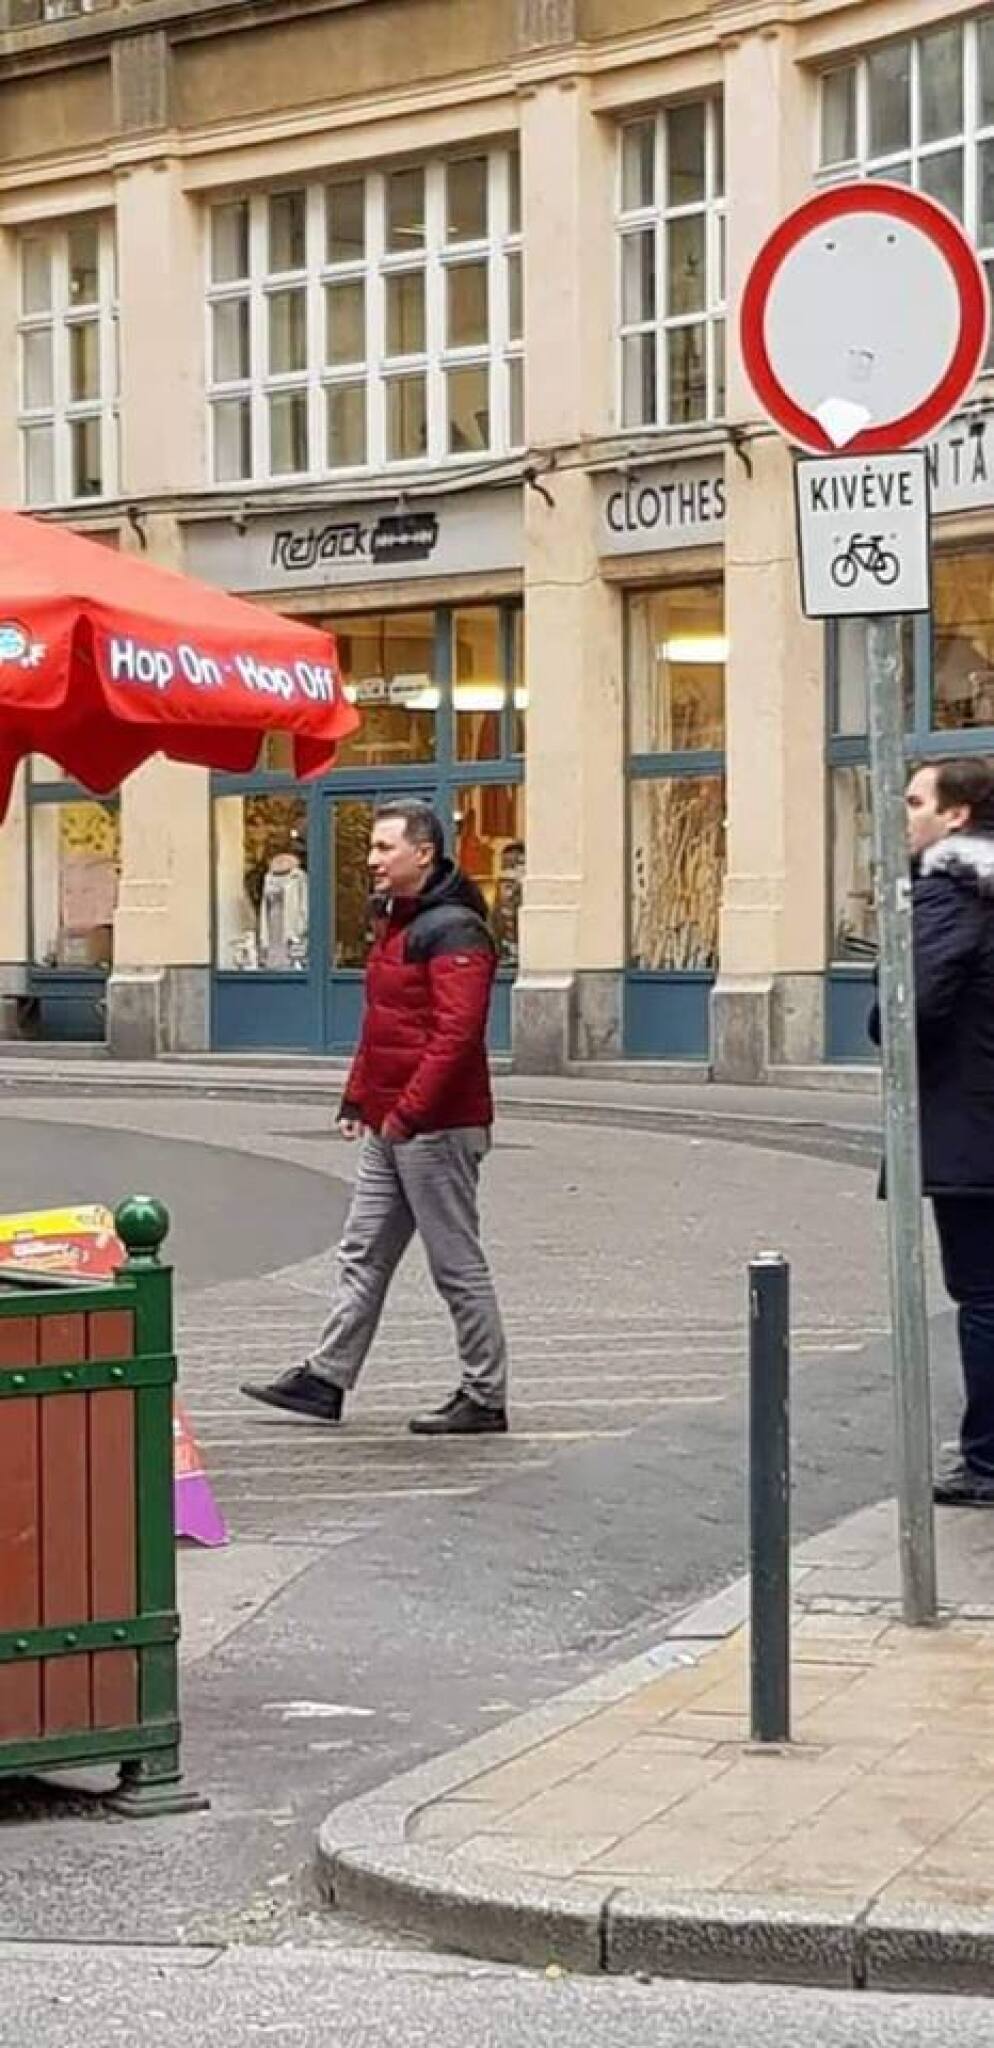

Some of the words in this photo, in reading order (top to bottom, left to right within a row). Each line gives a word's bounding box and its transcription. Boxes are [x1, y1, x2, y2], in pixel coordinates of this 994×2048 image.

[606, 477, 726, 532] CLOTHES
[810, 465, 914, 512] KIVÉVE
[111, 639, 174, 689] Hop
[177, 644, 223, 686] On
[235, 655, 293, 701] Hop
[295, 661, 333, 702] Off
